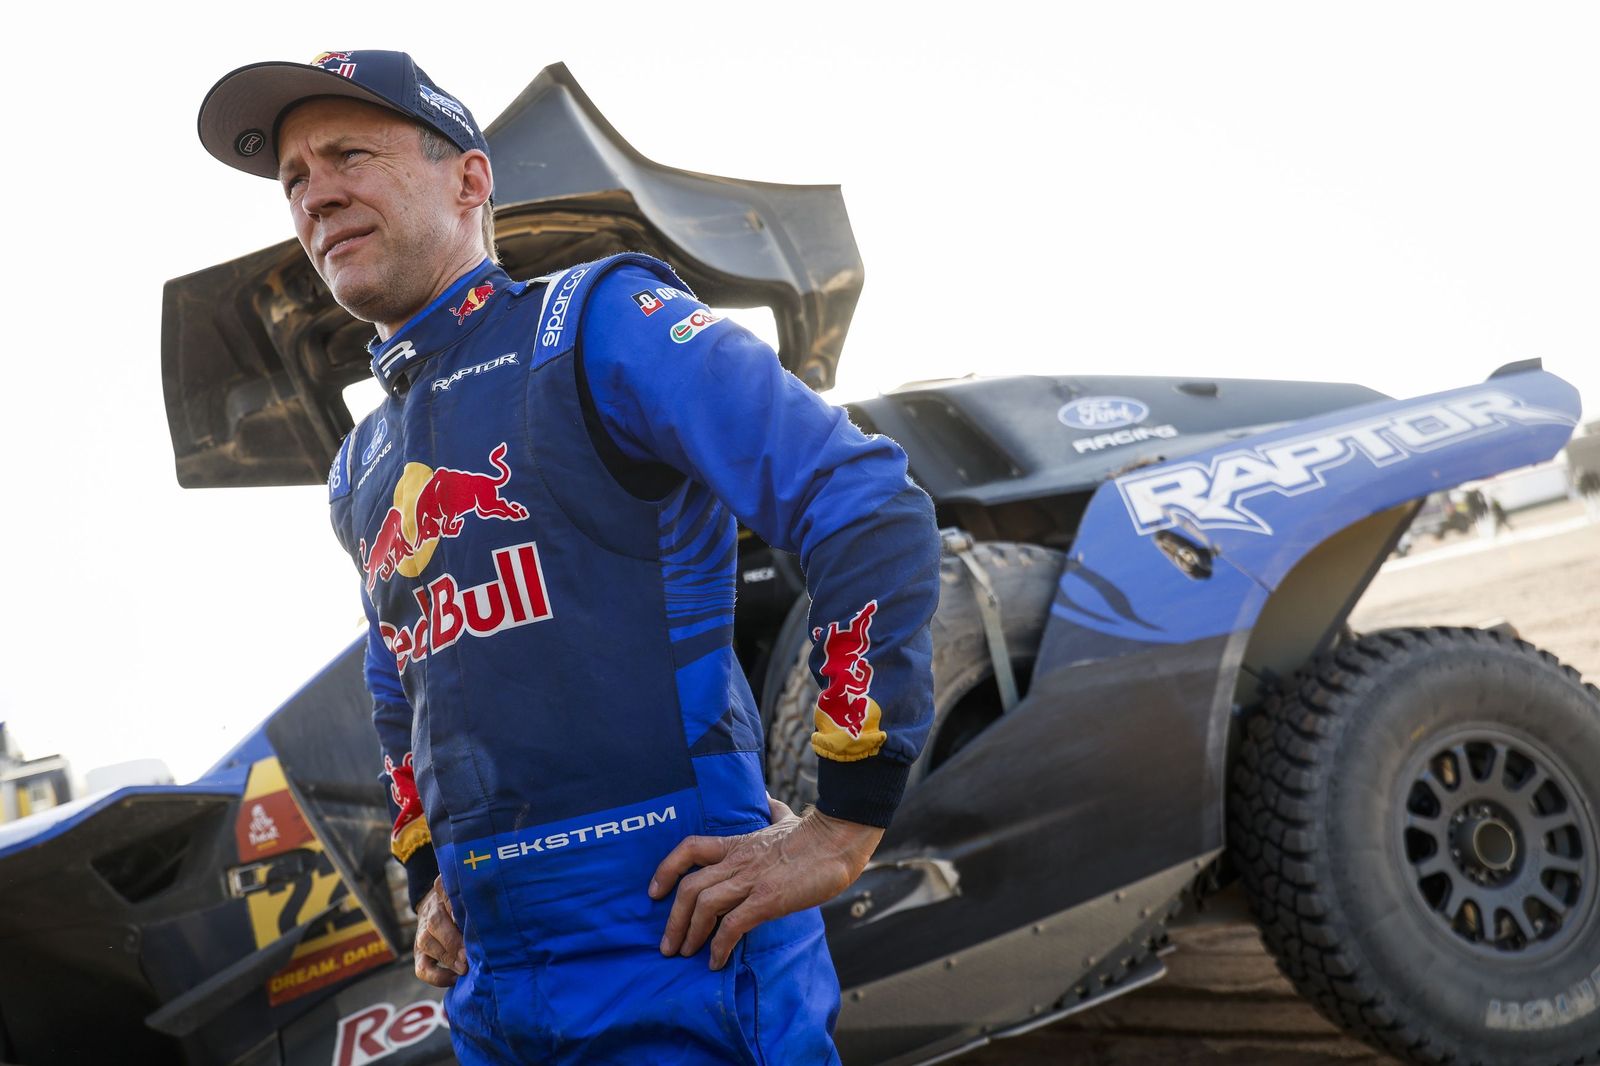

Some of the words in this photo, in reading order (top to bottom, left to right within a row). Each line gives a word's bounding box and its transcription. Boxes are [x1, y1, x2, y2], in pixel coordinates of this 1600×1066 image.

[542, 269, 588, 348] sparco
[431, 352, 519, 391] RAPTOR
[357, 440, 392, 490] RACING
[1071, 424, 1179, 454] RACING
[1115, 390, 1572, 536] RAPTOR
[430, 541, 554, 656] Bull
[497, 806, 677, 860] EKSTROM
[331, 1000, 449, 1066] Re
